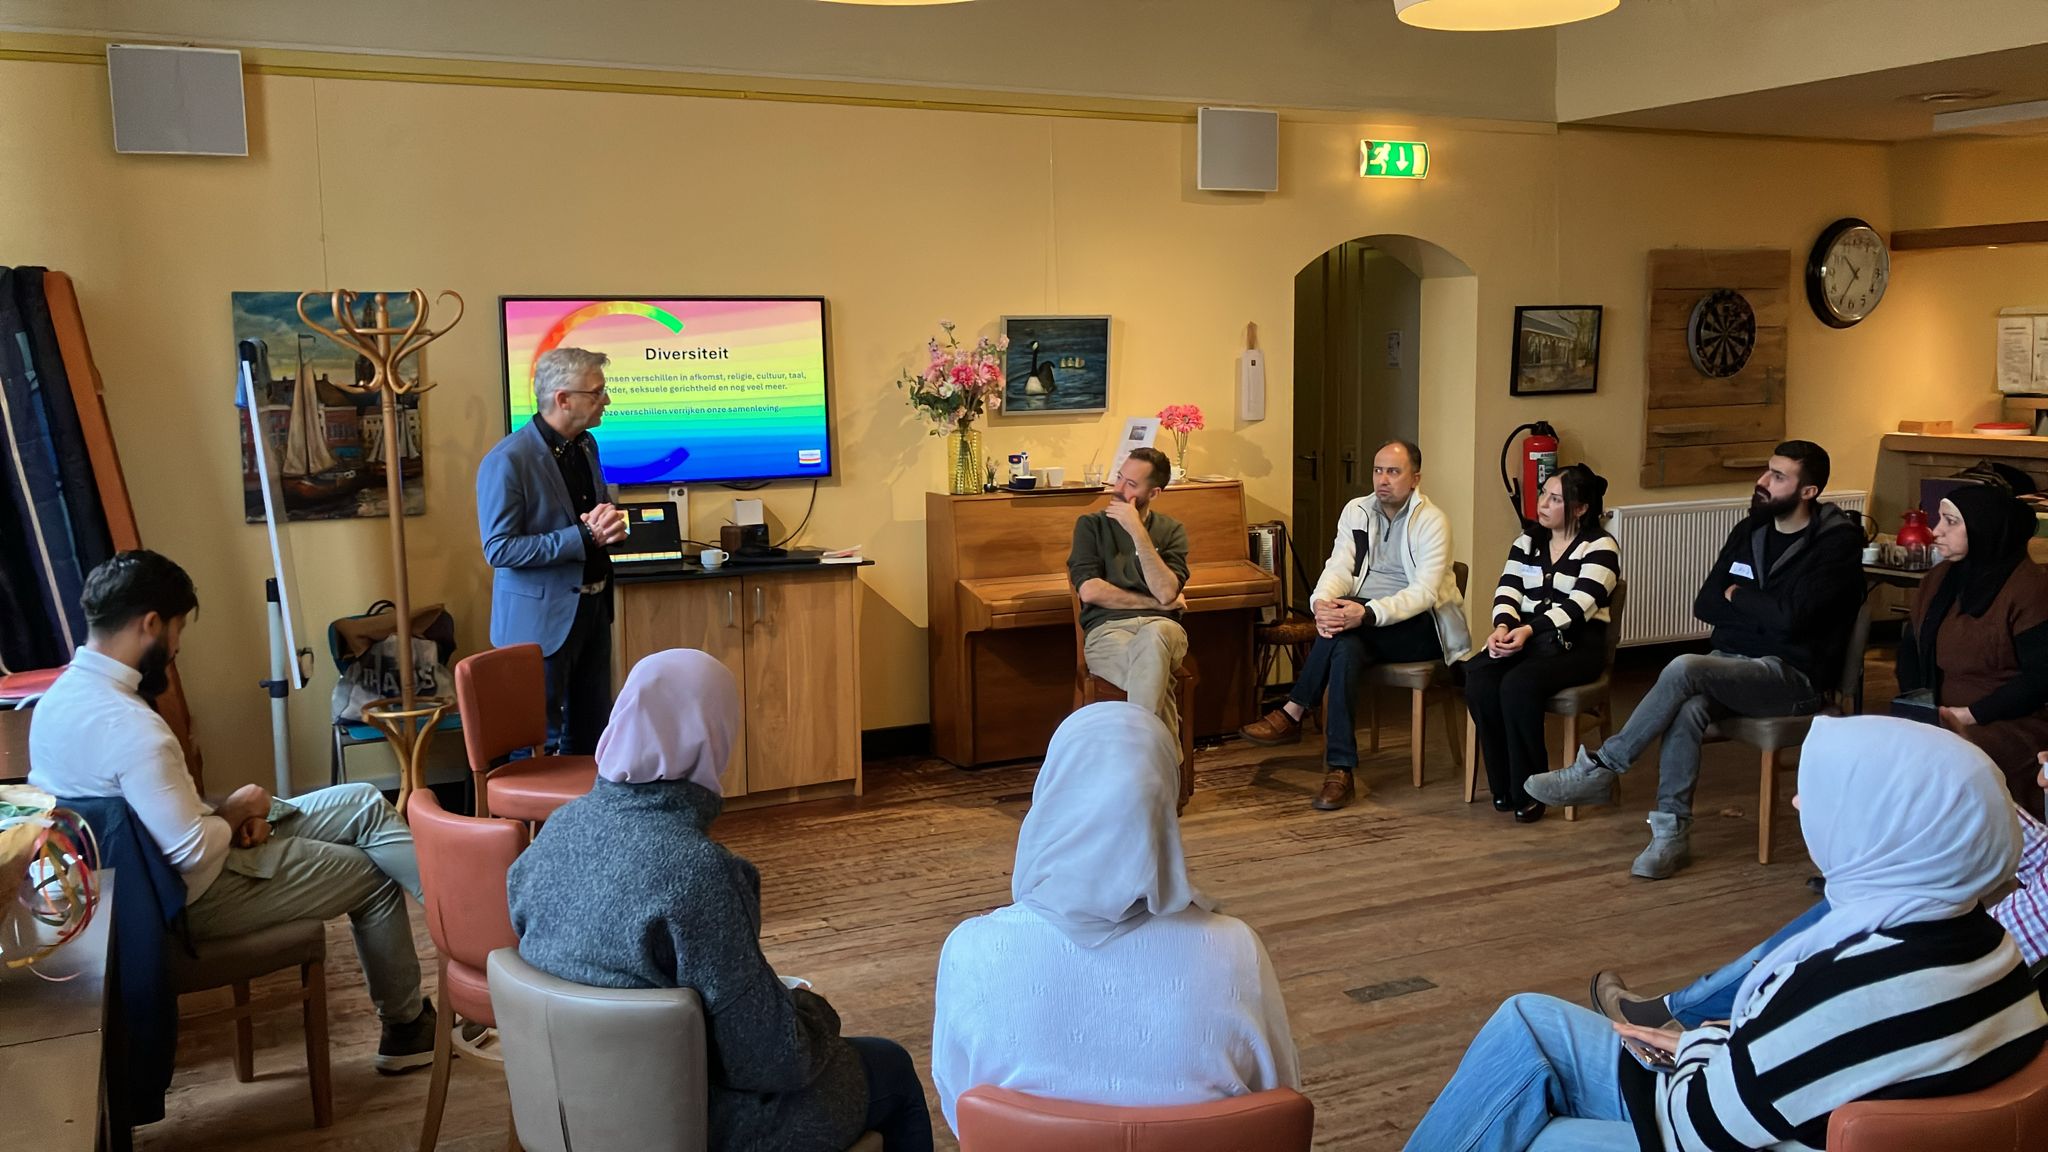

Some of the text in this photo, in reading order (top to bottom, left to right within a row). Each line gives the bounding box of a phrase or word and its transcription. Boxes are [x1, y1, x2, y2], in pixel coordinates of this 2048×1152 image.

[645, 347, 729, 360] Diversiteit
[631, 374, 678, 382] verschillen
[690, 373, 725, 382] afkomst,
[727, 373, 755, 381] religie,
[756, 372, 787, 380] cultuur,
[788, 372, 807, 380] taal,
[669, 384, 717, 393] gerichtheid
[620, 407, 668, 416] verschillen
[669, 406, 705, 416] verrijken
[706, 406, 727, 414] onze
